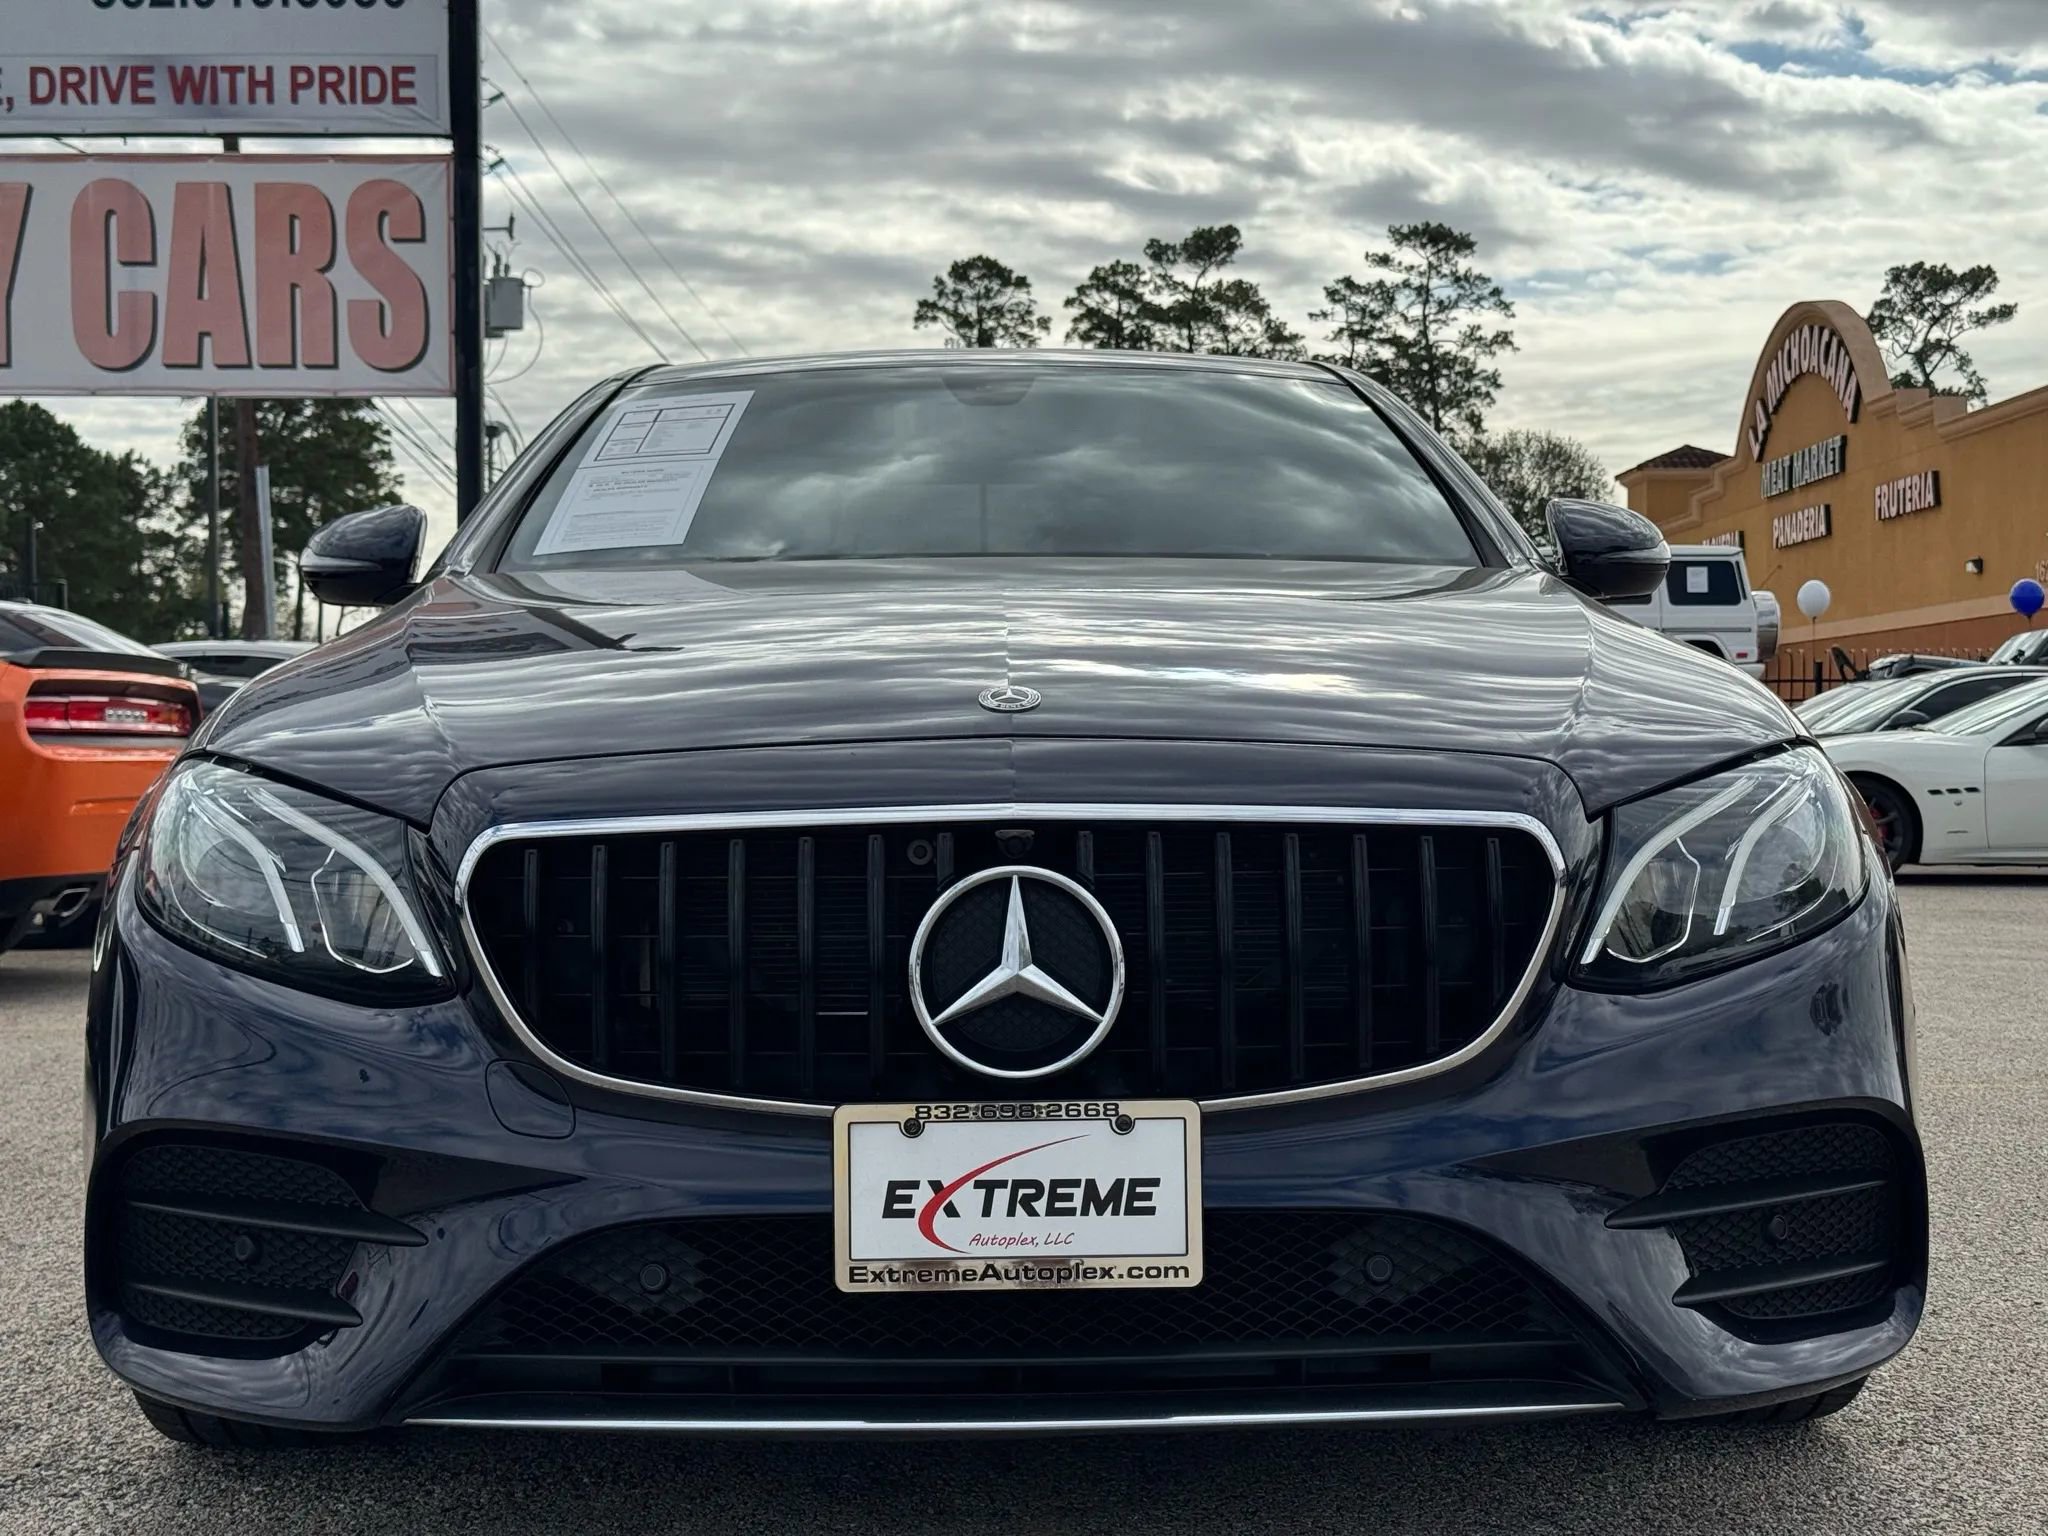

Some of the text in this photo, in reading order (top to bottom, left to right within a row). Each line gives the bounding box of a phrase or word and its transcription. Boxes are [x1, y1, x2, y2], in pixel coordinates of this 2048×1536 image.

[29, 65, 157, 106] DRIVE
[167, 65, 275, 106] WITH
[290, 65, 418, 106] PRIDE
[70, 177, 430, 373] CARS
[1748, 324, 1860, 463] LA MICHOACANA
[1761, 435, 1844, 500] MEAT MARKET
[1874, 470, 1935, 521] FRUTERIA
[1772, 504, 1828, 550] PANADERIA
[881, 1177, 1162, 1219] EXTREME
[968, 1231, 1076, 1250] Autoplex, LLC
[848, 1258, 1190, 1285] ExtremeAutoplex.com
